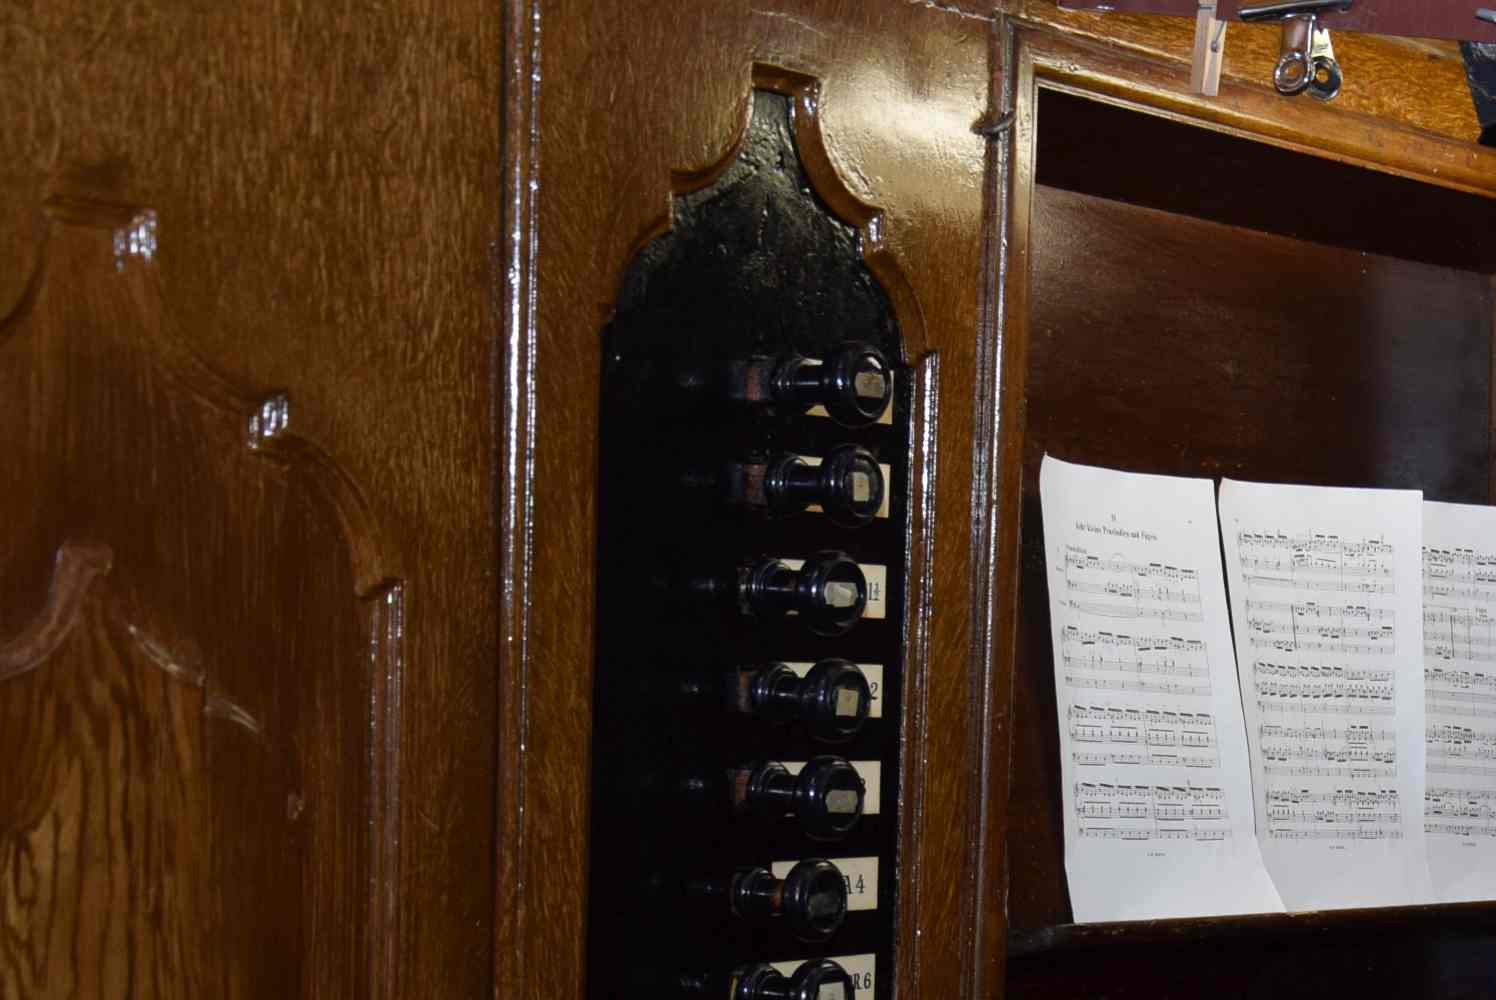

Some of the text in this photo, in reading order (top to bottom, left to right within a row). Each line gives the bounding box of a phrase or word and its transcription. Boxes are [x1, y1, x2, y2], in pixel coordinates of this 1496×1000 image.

[870, 681, 879, 700] 2
[855, 873, 867, 894] 4
[863, 972, 872, 990] 6
